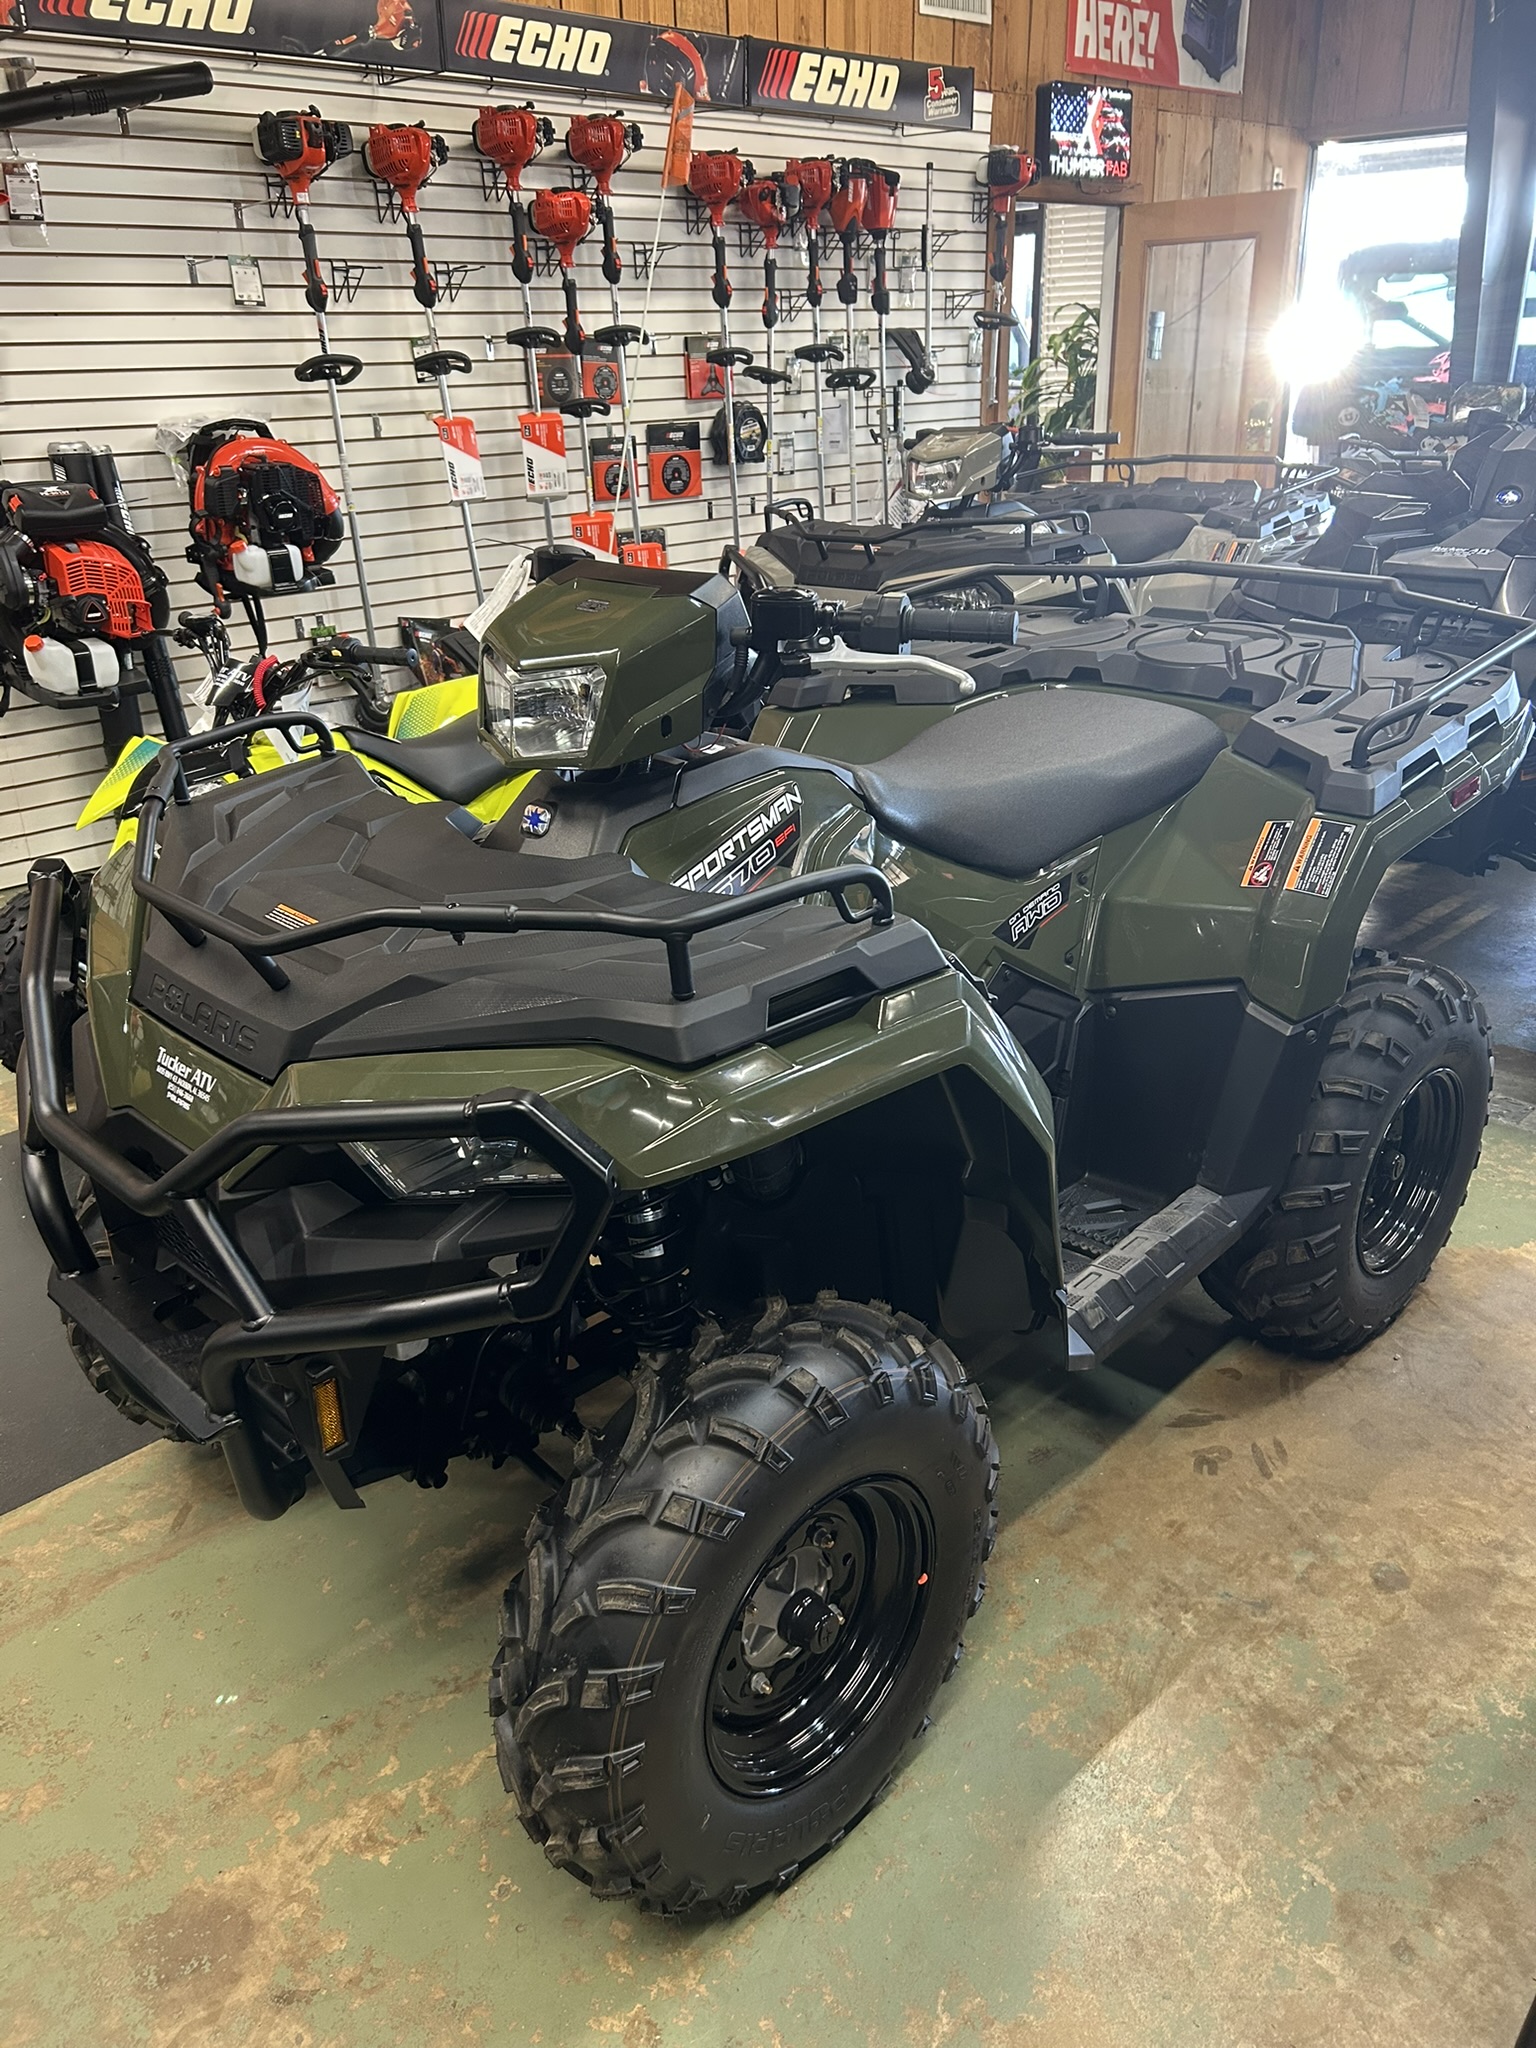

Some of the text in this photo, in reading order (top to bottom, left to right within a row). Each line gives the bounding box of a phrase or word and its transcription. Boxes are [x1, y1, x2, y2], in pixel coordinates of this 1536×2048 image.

[489, 15, 612, 76] ECHO
[1074, 0, 1160, 70] HERE!
[789, 52, 900, 111] ECHO
[928, 67, 945, 100] 5
[447, 460, 458, 490] ECHO
[526, 457, 535, 485] ECHO
[669, 782, 804, 892] SPORTSMAN
[774, 823, 797, 848] EFI
[1297, 834, 1312, 865] WARNING
[1011, 891, 1062, 942] AWD
[147, 973, 260, 1052] POLARIS
[156, 1045, 218, 1093] Tucker ATV
[724, 1784, 849, 1858] POLARIS
